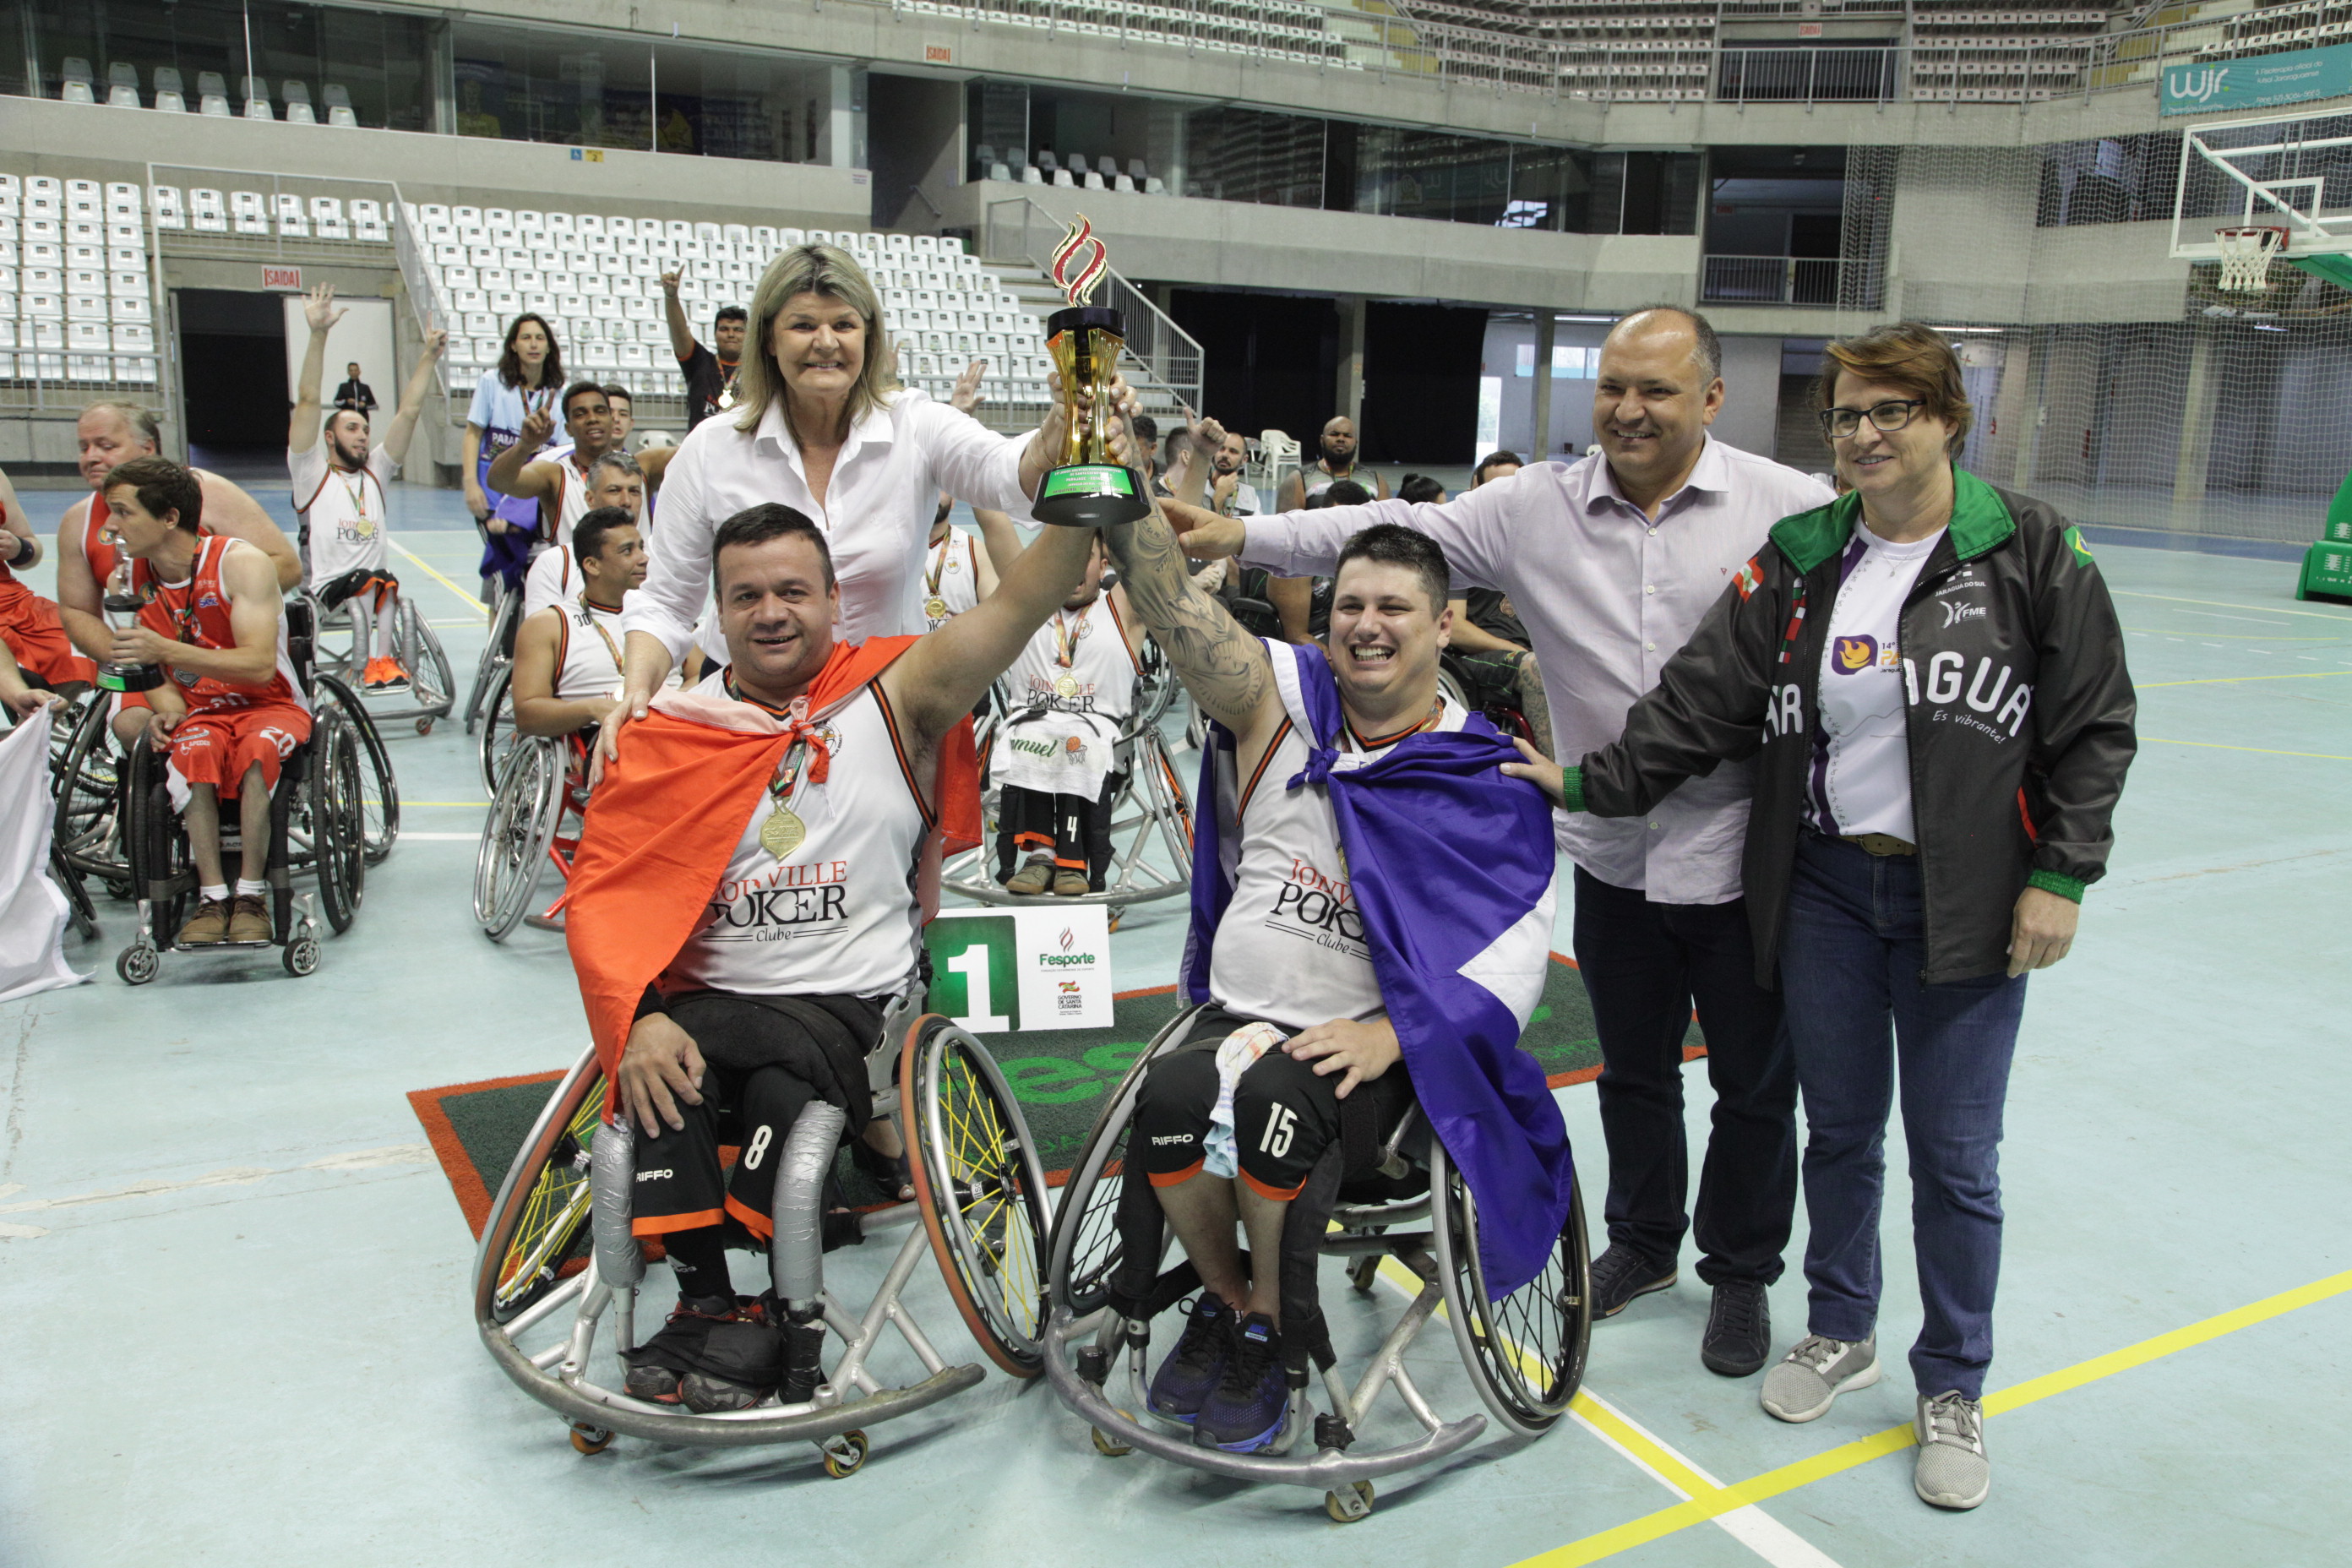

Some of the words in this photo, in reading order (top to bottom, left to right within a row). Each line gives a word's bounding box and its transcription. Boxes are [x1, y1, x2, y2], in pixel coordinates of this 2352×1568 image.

[574, 612, 591, 627] 30
[1963, 607, 1987, 618] FME
[1933, 710, 1947, 721] Es
[1955, 714, 2006, 744] vibrante!
[1067, 816, 1077, 842] 4
[756, 928, 792, 942] Clube
[1316, 933, 1350, 954] Clube
[1039, 951, 1096, 968] Fesporte
[947, 944, 1010, 1033] 1
[1152, 1133, 1194, 1146] RIFFO
[1259, 1102, 1298, 1158] 15
[744, 1124, 773, 1170] 8
[636, 1168, 673, 1183] RIFFO
